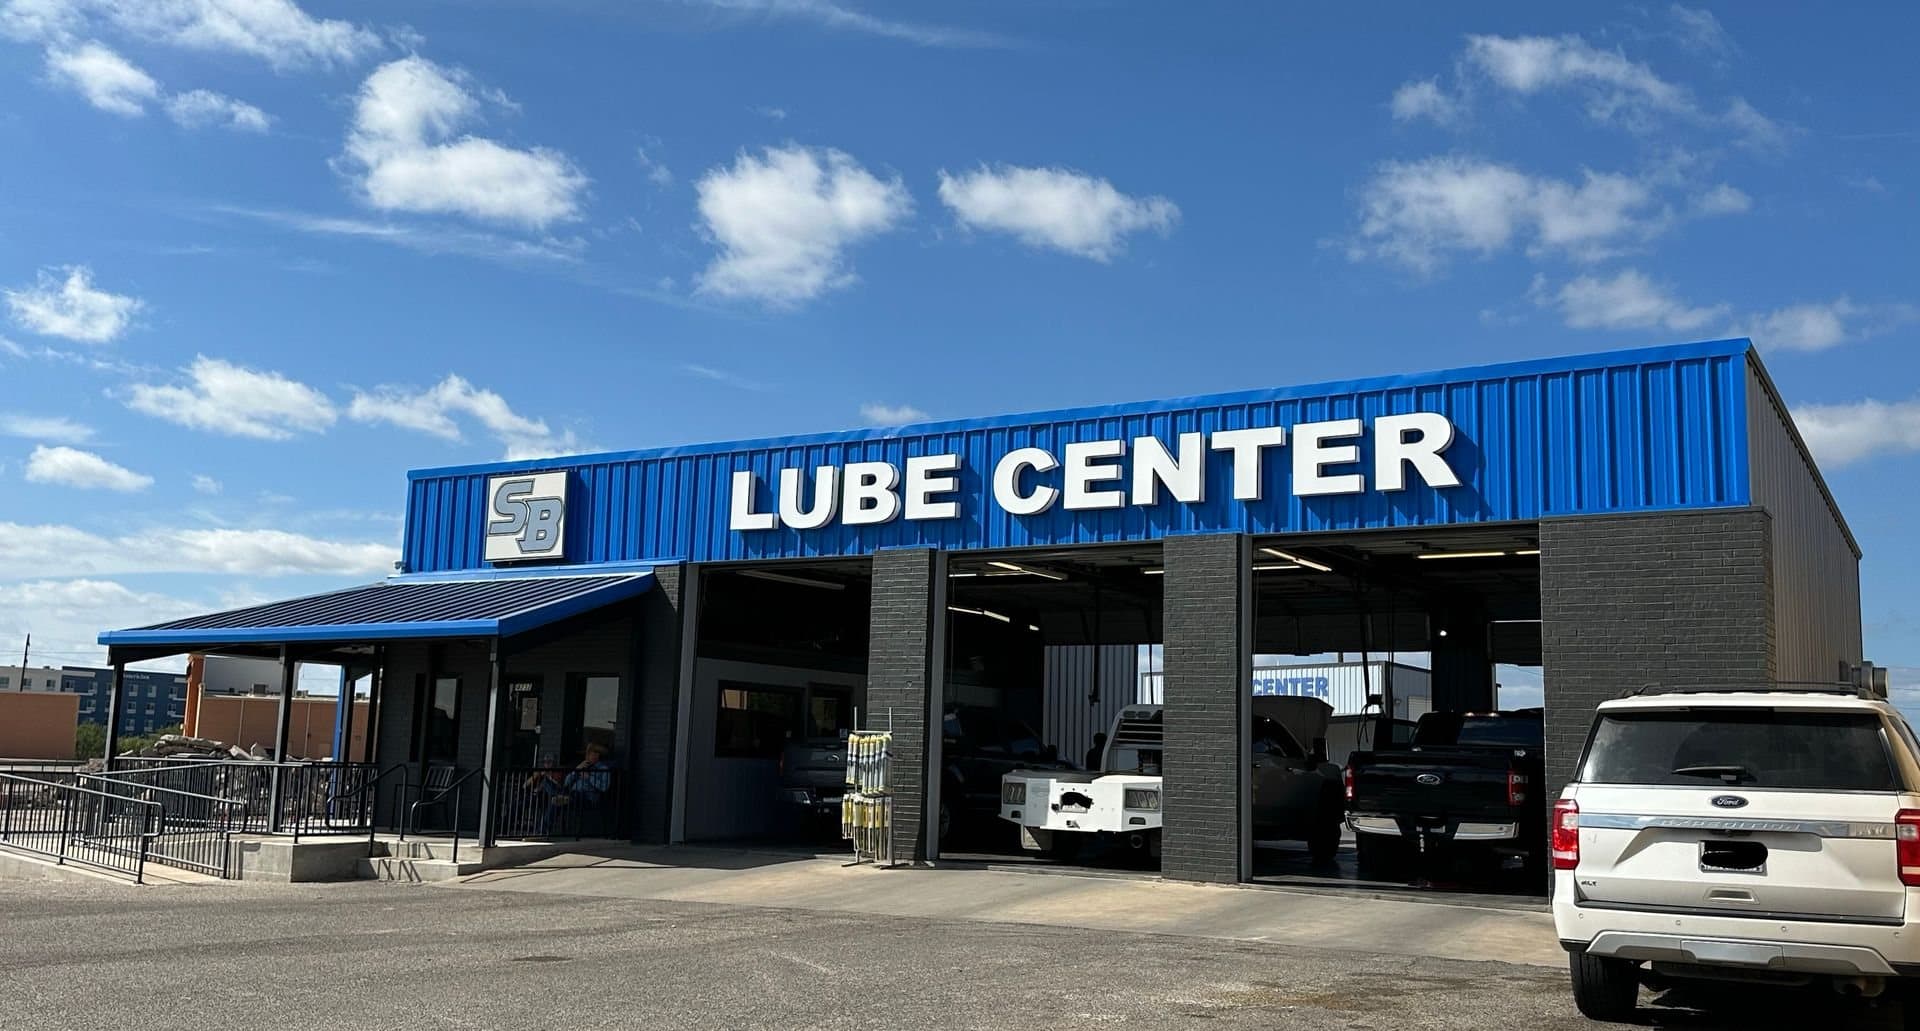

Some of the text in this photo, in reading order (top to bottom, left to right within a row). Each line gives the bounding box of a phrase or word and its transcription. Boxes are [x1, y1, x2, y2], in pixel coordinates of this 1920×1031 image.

[730, 411, 1462, 530] LUBE CENTER
[488, 477, 564, 554] SB
[1252, 676, 1328, 697] CENTER
[1715, 796, 1740, 807] Ford
